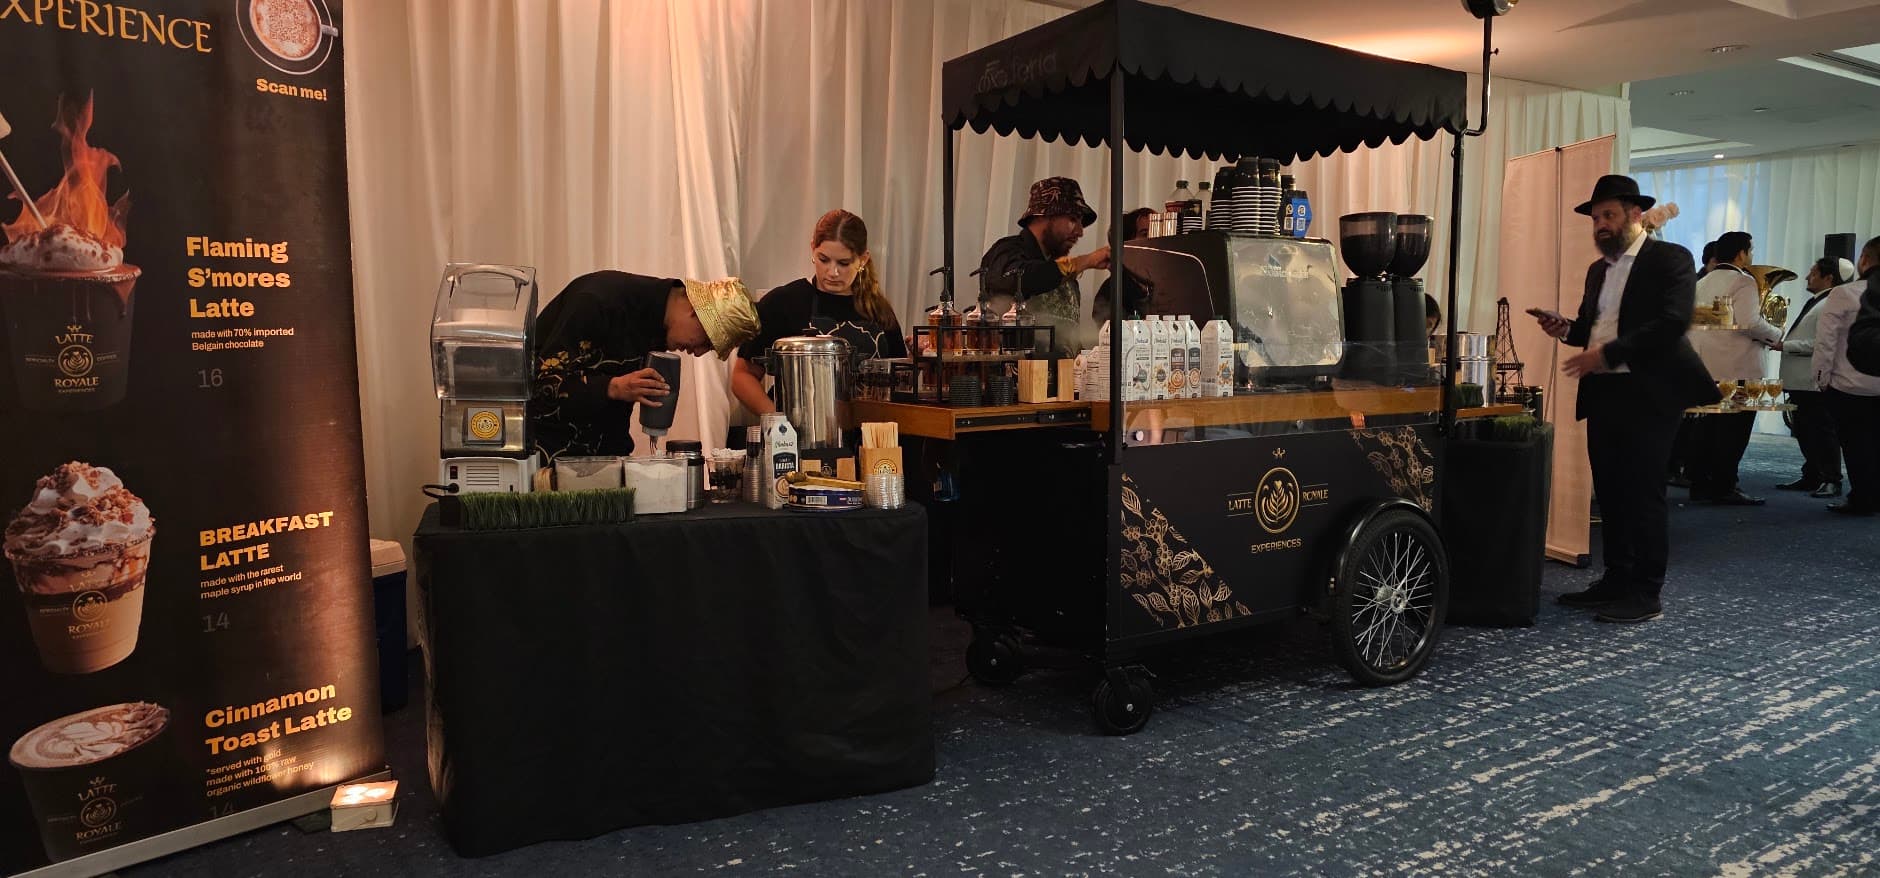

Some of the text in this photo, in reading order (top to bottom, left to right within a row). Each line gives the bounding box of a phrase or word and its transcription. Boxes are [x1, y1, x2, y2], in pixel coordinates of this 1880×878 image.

[256, 78, 327, 101] Scan me!
[186, 236, 289, 264] Flaming
[187, 267, 291, 288] S’mores
[190, 298, 255, 318] Latte
[55, 333, 94, 344] LATTE
[191, 327, 295, 338] made with 70% imported
[192, 339, 264, 351] Belgain chocolate
[54, 376, 99, 388] ROYALE
[198, 368, 224, 388] 16
[1228, 498, 1252, 511] LATTE
[1302, 489, 1329, 501] ROYALE
[199, 511, 334, 547] BREAKFAST
[200, 542, 270, 571] LATTE
[1251, 538, 1302, 554] EXPERIENCES
[200, 564, 284, 588] made with the rarest
[200, 571, 302, 600] maple syrup in the world
[203, 611, 230, 633] 14
[205, 684, 336, 728] Cinnamon
[204, 706, 352, 755] Toast Latte
[206, 775, 233, 787] made
[234, 768, 254, 780] with
[281, 755, 297, 766] raw
[242, 756, 263, 767] with
[206, 761, 315, 798] organic wildflower honey
[78, 783, 117, 801] LATTE
